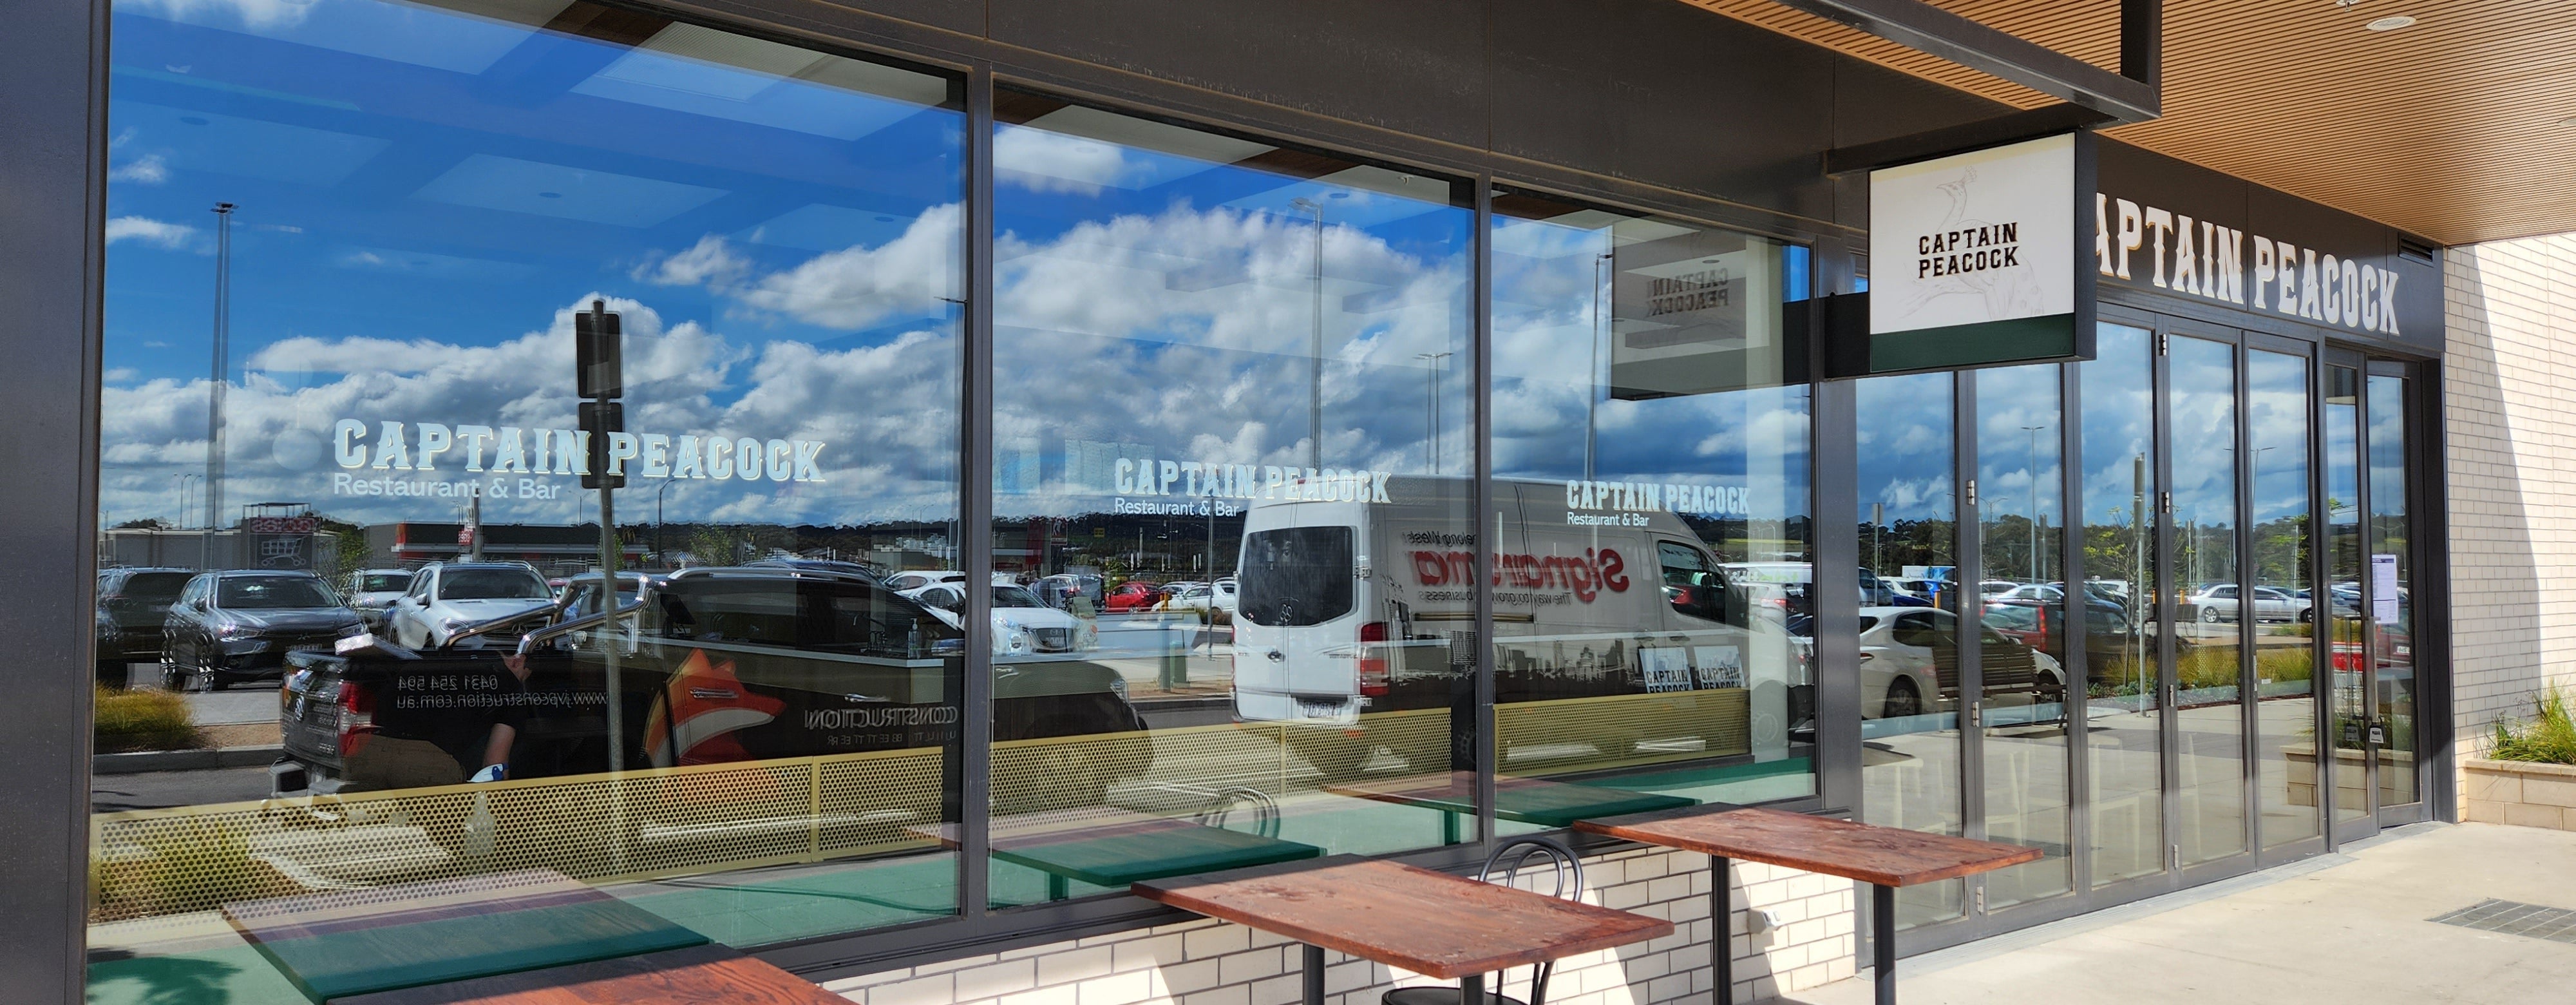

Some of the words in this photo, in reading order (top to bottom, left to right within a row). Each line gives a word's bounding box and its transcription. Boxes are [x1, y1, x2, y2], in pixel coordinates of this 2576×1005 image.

[1918, 222, 2018, 256] CAPTAIN
[1918, 245, 2020, 279] PEACOCK
[2096, 192, 2244, 305] APTAIN
[2253, 235, 2401, 336] PEACOCK
[333, 418, 592, 475] CAPTAIN
[607, 431, 826, 482] PEACOCK
[334, 472, 480, 498] Restaurant
[488, 477, 509, 499] &
[518, 478, 561, 500] Bar
[1114, 457, 1256, 499] CAPTAIN
[1264, 465, 1392, 504] PEACOCK
[1566, 479, 1661, 512] CAPTAIN
[1665, 484, 1752, 515] PEACOCK
[1115, 497, 1195, 516] Restaurant
[1198, 500, 1211, 516] &
[1215, 501, 1240, 517] Bar
[1567, 512, 1620, 526] Restaurant
[1622, 513, 1631, 526] &
[1632, 513, 1650, 527] Bar
[1646, 669, 1689, 685] CAPTAIN
[1700, 666, 1741, 682] CAPTAIN
